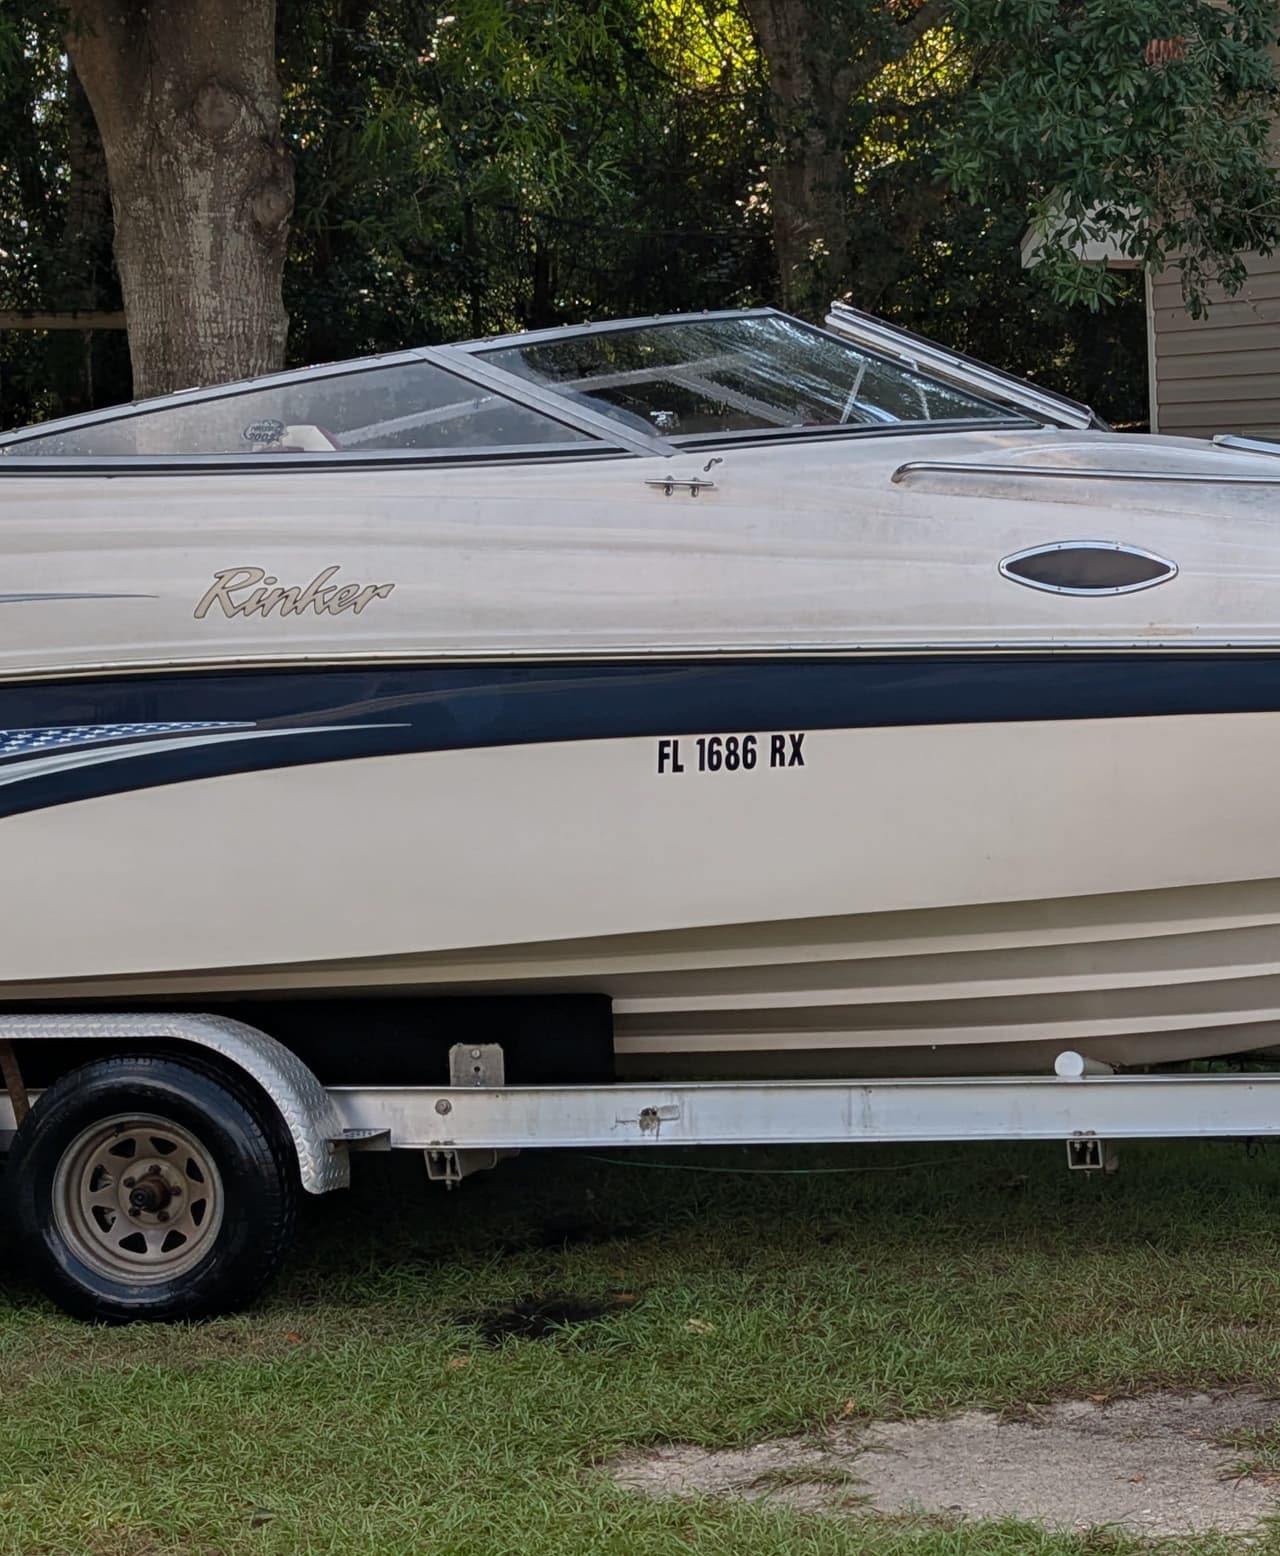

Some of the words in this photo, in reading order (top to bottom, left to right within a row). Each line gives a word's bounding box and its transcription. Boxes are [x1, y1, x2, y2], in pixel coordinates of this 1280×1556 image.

[194, 565, 395, 619] Rinker
[658, 740, 684, 773] FL
[696, 735, 757, 772] 1686
[770, 733, 805, 767] RX
